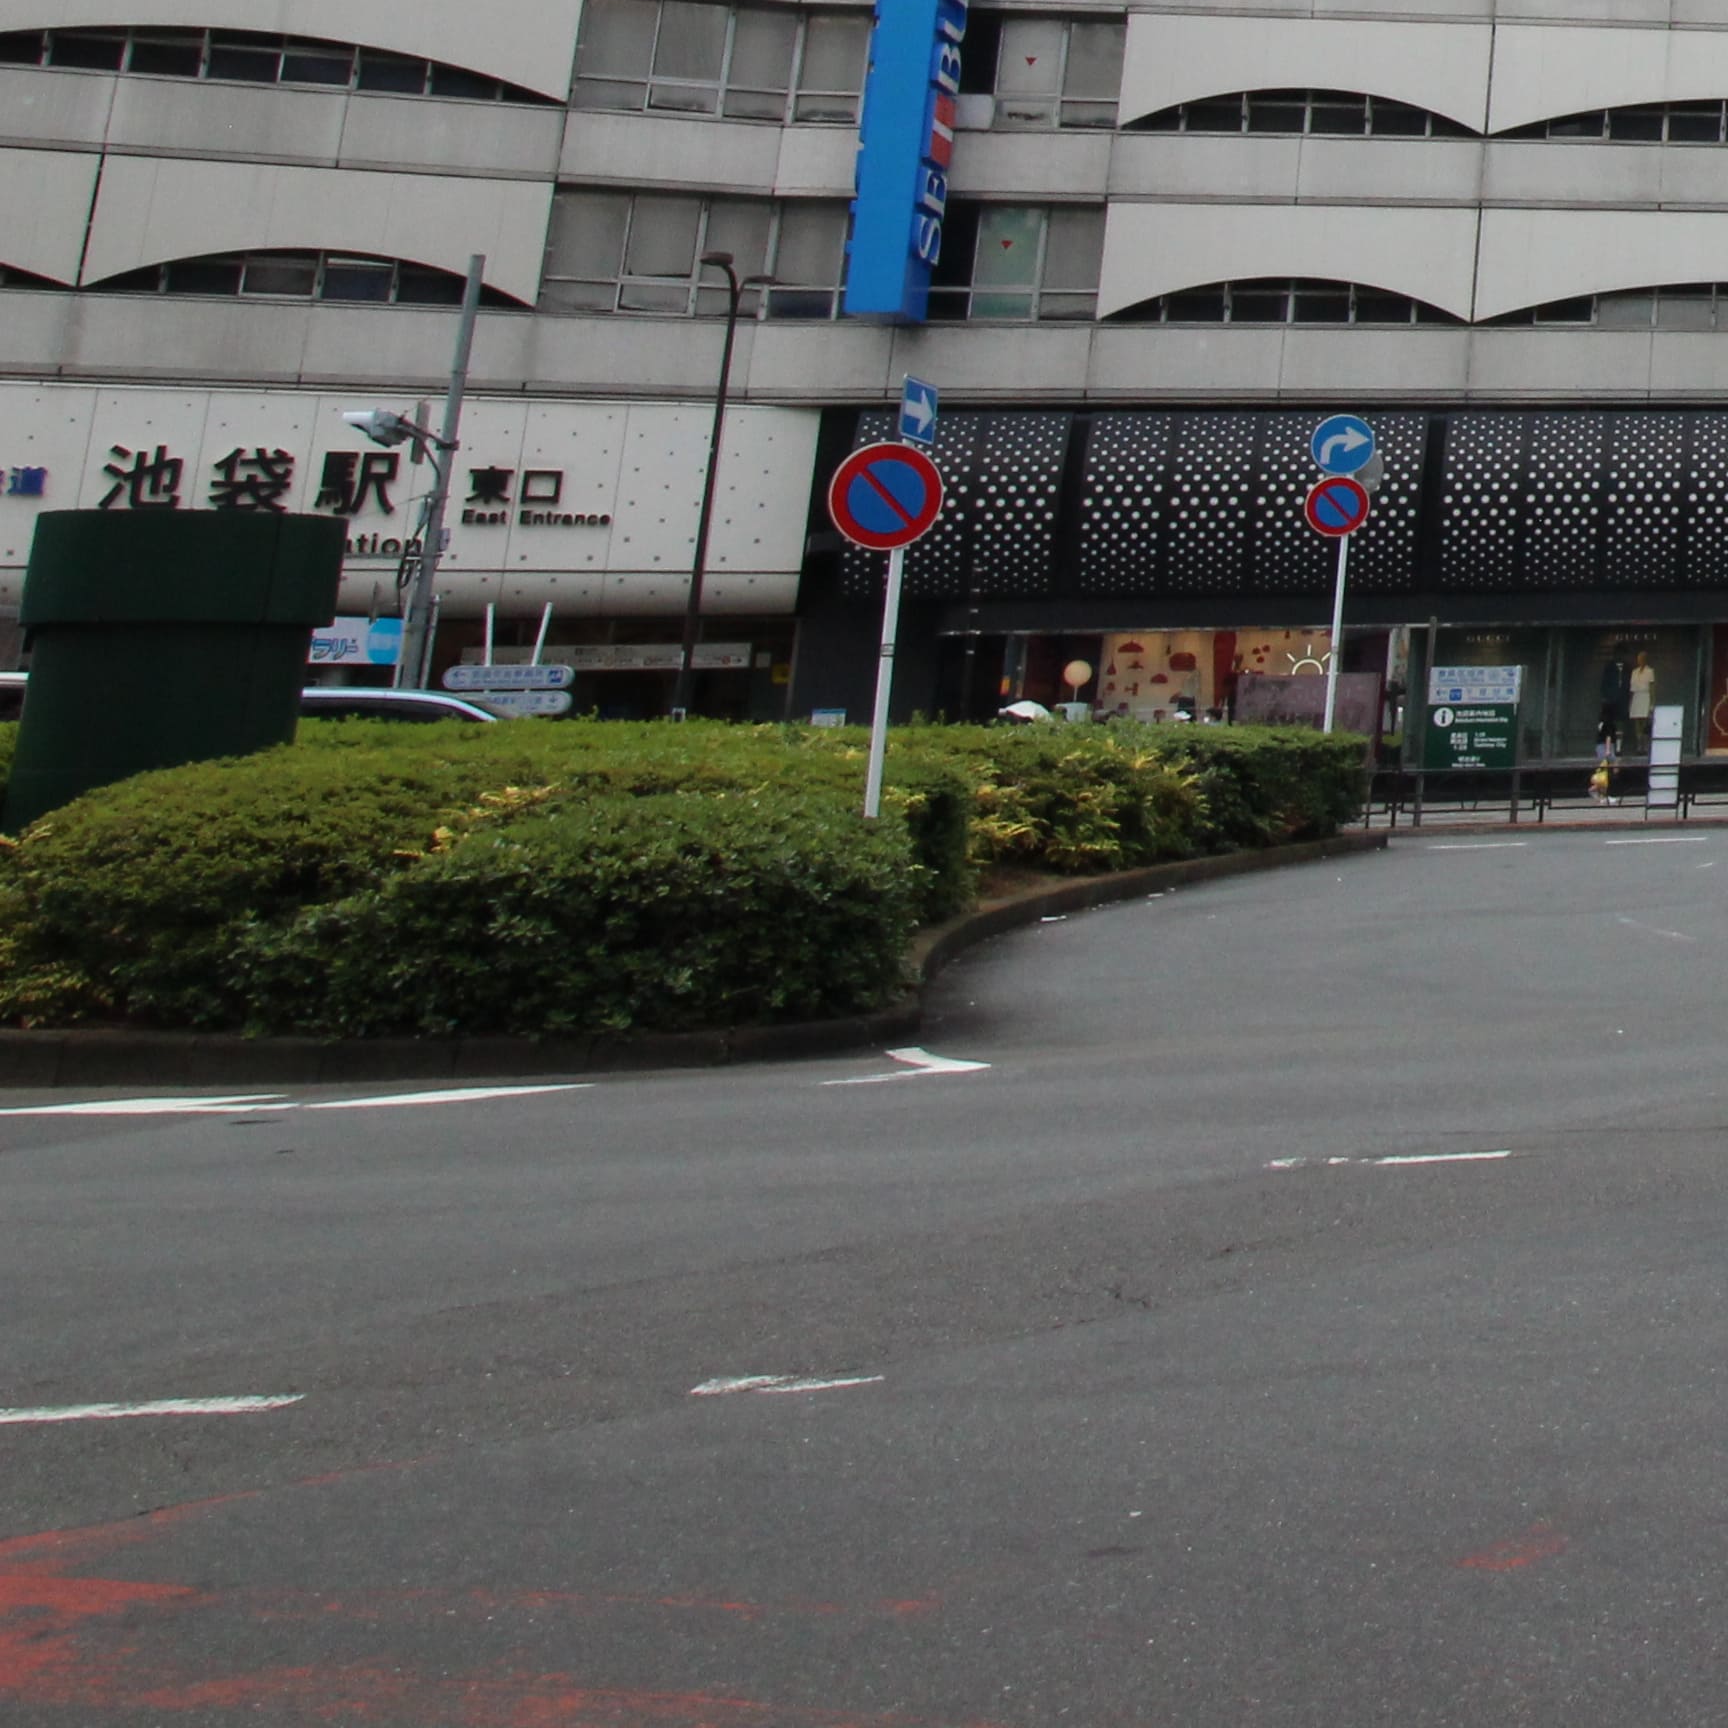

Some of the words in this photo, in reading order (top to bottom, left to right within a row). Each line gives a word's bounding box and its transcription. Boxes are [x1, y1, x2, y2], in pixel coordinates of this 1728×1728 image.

[99, 444, 400, 515] 池袋駅
[465, 466, 564, 505] 東口
[461, 509, 506, 526] East
[520, 510, 610, 527] Entrance
